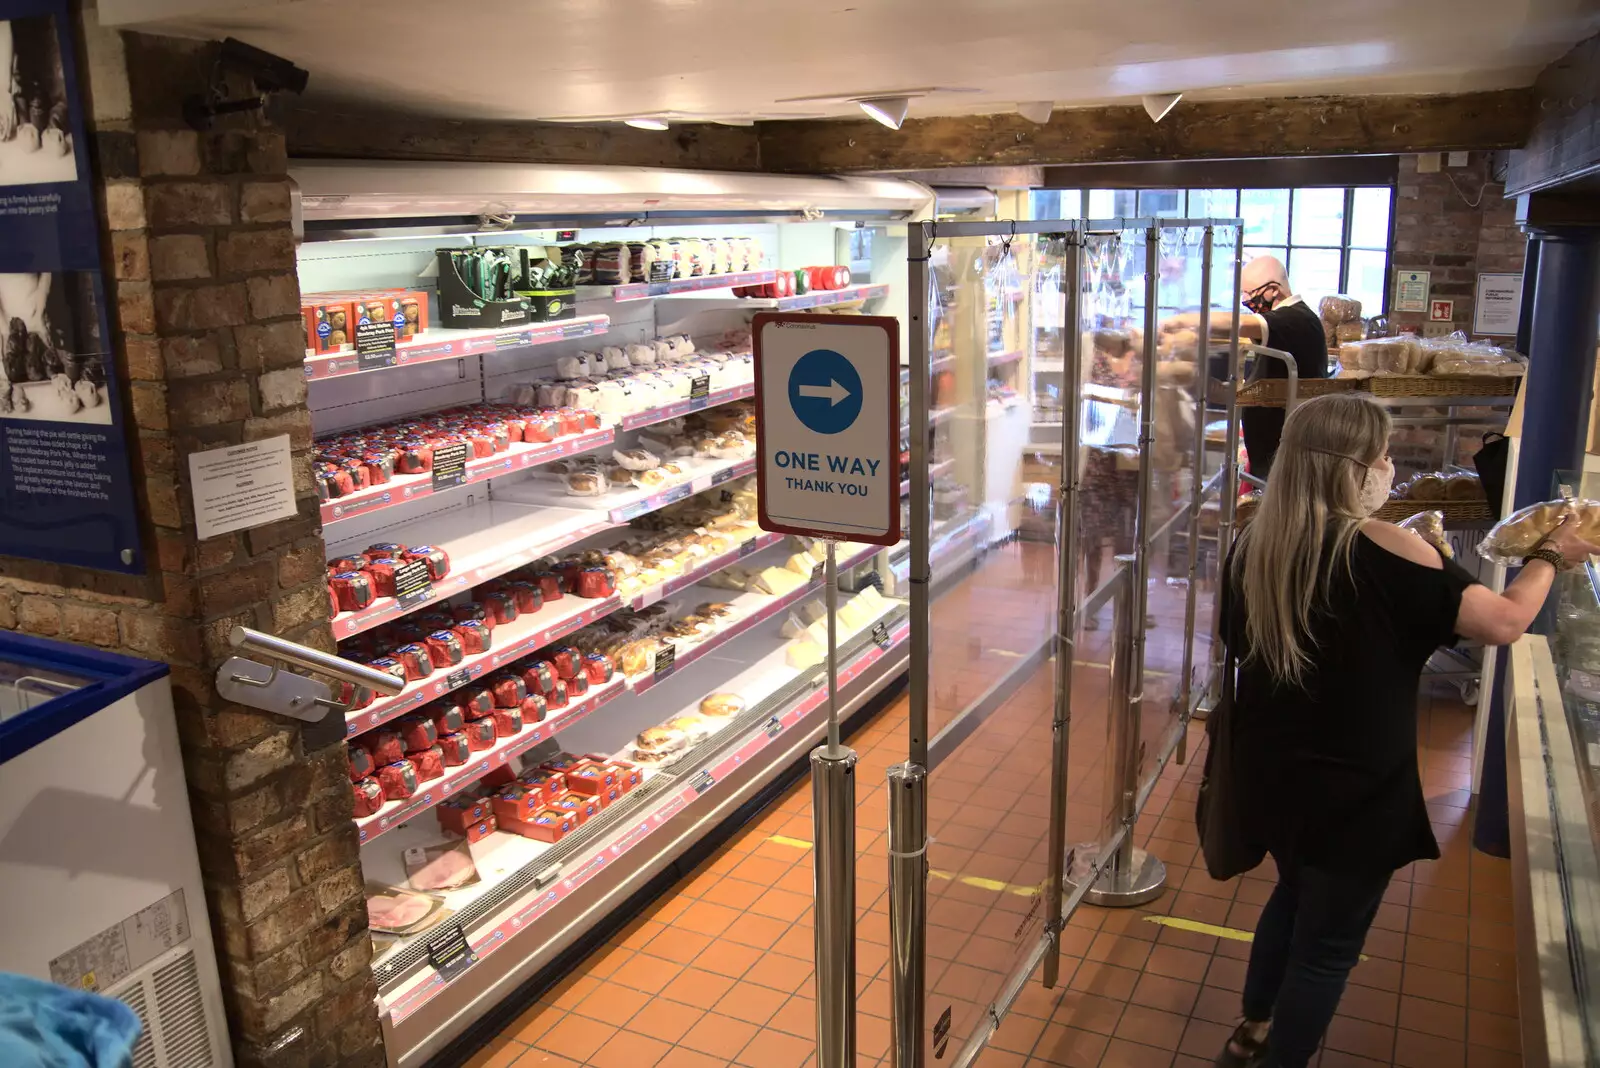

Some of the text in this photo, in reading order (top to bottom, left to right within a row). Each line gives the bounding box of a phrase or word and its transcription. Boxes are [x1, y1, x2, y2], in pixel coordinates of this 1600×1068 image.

[12, 195, 28, 205] firmly
[28, 194, 38, 203] but
[38, 193, 61, 204] carefully
[18, 206, 27, 214] the
[28, 206, 44, 216] pastry
[44, 204, 58, 212] shell
[6, 427, 23, 438] During
[23, 428, 40, 438] baking
[66, 432, 81, 440] settle
[82, 434, 98, 443] giving
[9, 446, 26, 454] Melton
[26, 447, 50, 457] Mowbray
[50, 449, 62, 457] Pork
[72, 452, 87, 460] When
[98, 454, 106, 462] pie
[66, 442, 81, 450] shape
[11, 455, 20, 463] has
[37, 458, 50, 466] bone
[64, 460, 75, 470] jelly
[775, 450, 880, 477] ONE WAY
[12, 464, 23, 473] This
[23, 466, 44, 476] replaces
[66, 470, 76, 478] lost
[76, 471, 94, 481] during
[94, 472, 112, 483] baking
[24, 476, 41, 485] greatly
[41, 478, 64, 486] improves
[16, 484, 31, 494] eating
[31, 486, 52, 495] qualities
[67, 488, 87, 498] finished
[88, 490, 100, 499] Pork
[100, 492, 109, 500] Pie
[785, 477, 868, 497] THANK YOU
